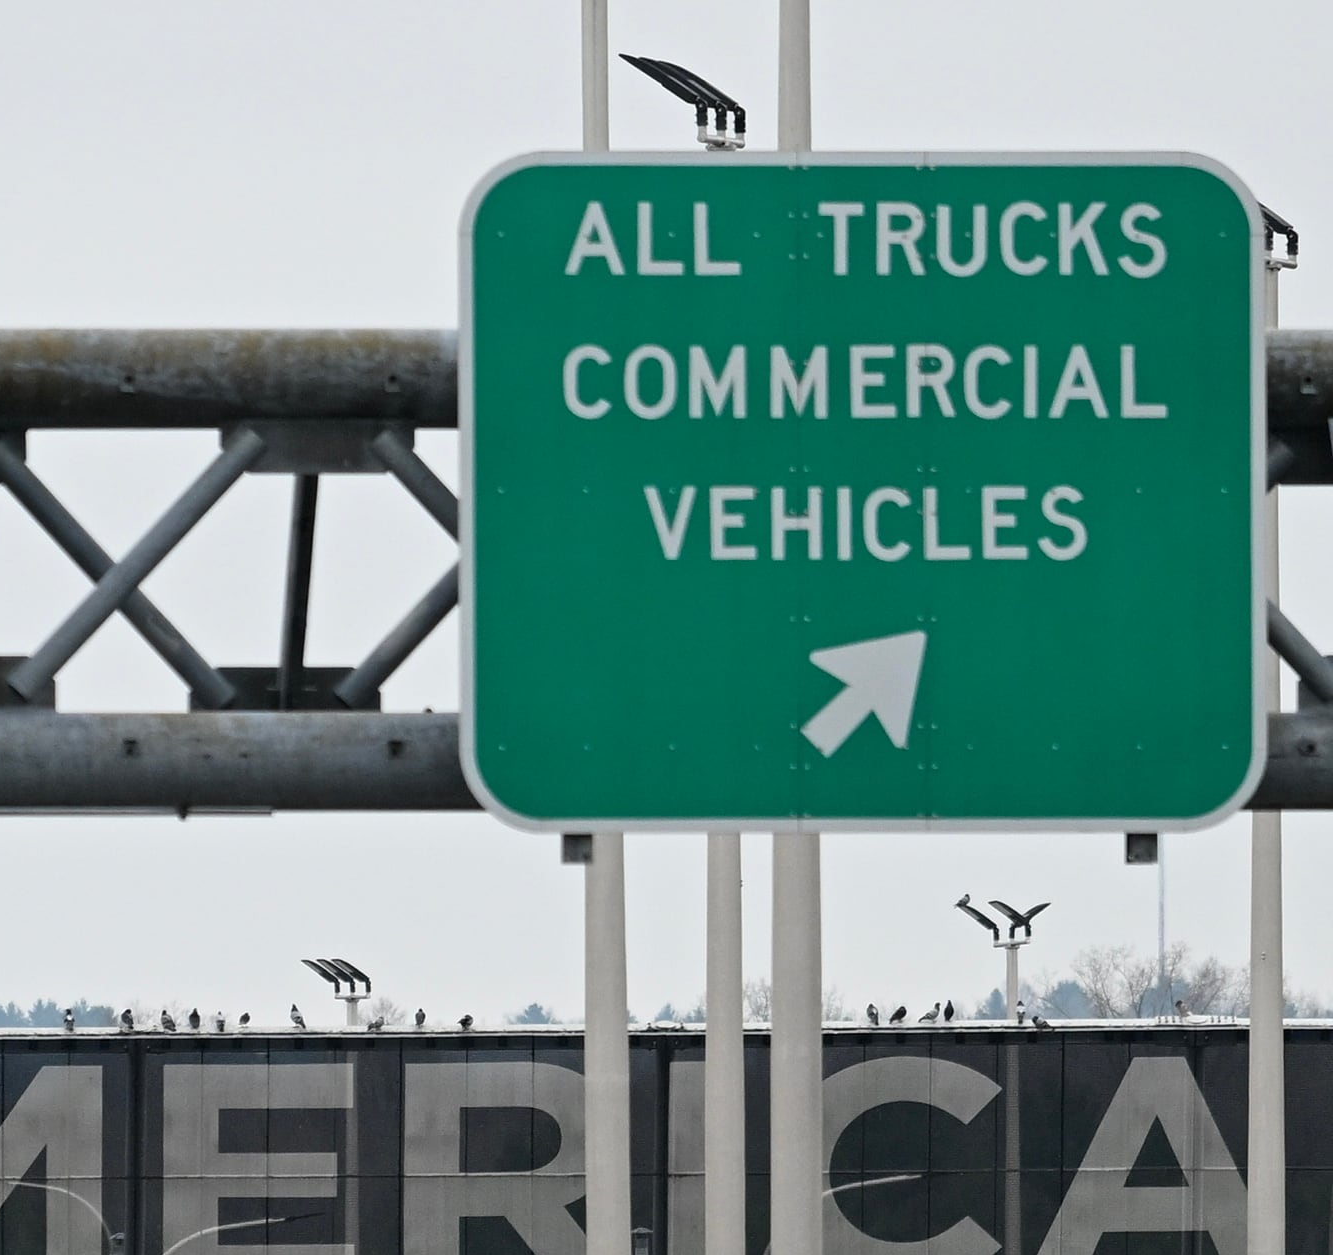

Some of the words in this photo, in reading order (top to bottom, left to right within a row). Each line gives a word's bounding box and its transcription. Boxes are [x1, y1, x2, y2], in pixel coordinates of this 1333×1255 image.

[565, 202, 742, 276] ALL
[818, 202, 1168, 278] TRUCKS
[562, 345, 1169, 420] COMMERCIAL
[644, 485, 1088, 561] VEHICLES
